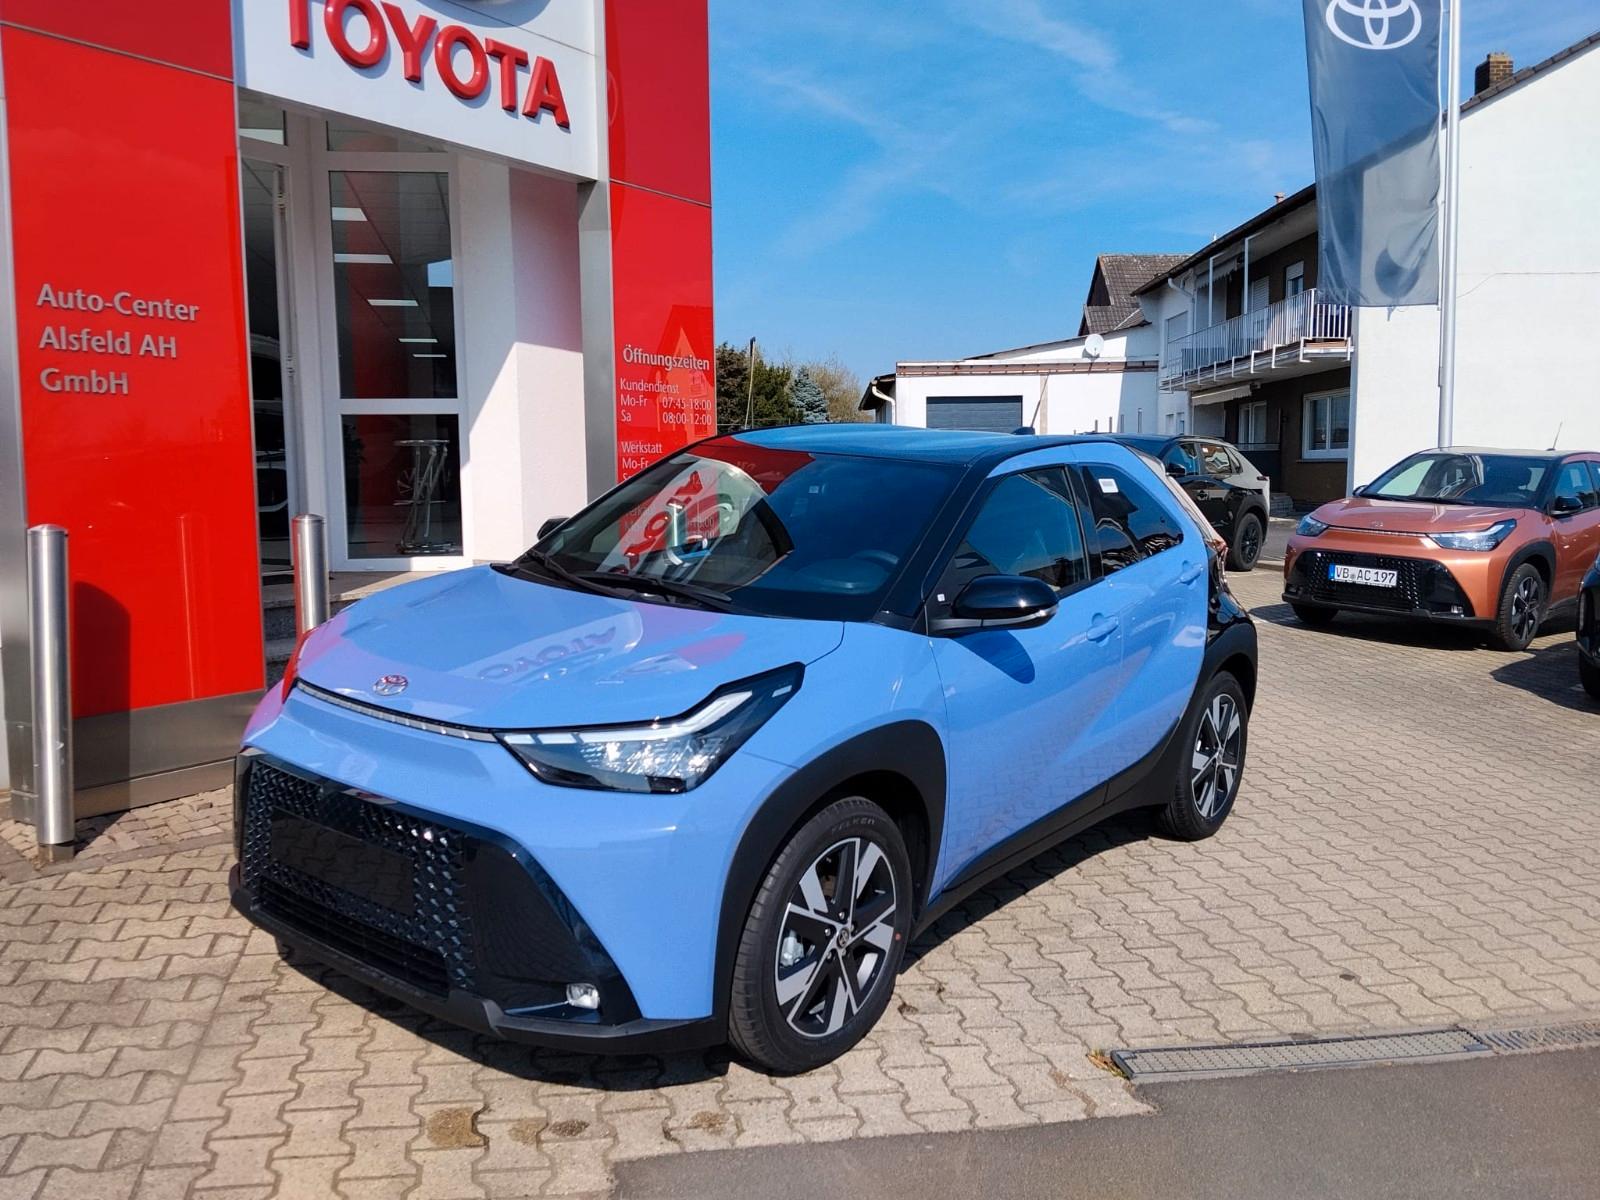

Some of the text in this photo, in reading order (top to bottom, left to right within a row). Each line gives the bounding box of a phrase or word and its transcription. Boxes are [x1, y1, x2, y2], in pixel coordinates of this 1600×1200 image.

[36, 283, 200, 322] Auto-Center
[38, 325, 178, 359] Alsfeld AH
[622, 344, 710, 371] Öffnungszeiten
[39, 367, 129, 396] GmbH
[620, 378, 680, 394] Kundendienst
[620, 395, 648, 408] Mo-Fr
[620, 409, 712, 426] Sa 08:00-12:00
[621, 441, 663, 455] Werkstatt
[622, 457, 649, 470] Mo-Fr
[622, 473, 633, 481] S
[1336, 567, 1350, 579] VB
[1357, 569, 1371, 581] AC
[1373, 571, 1396, 584] 197
